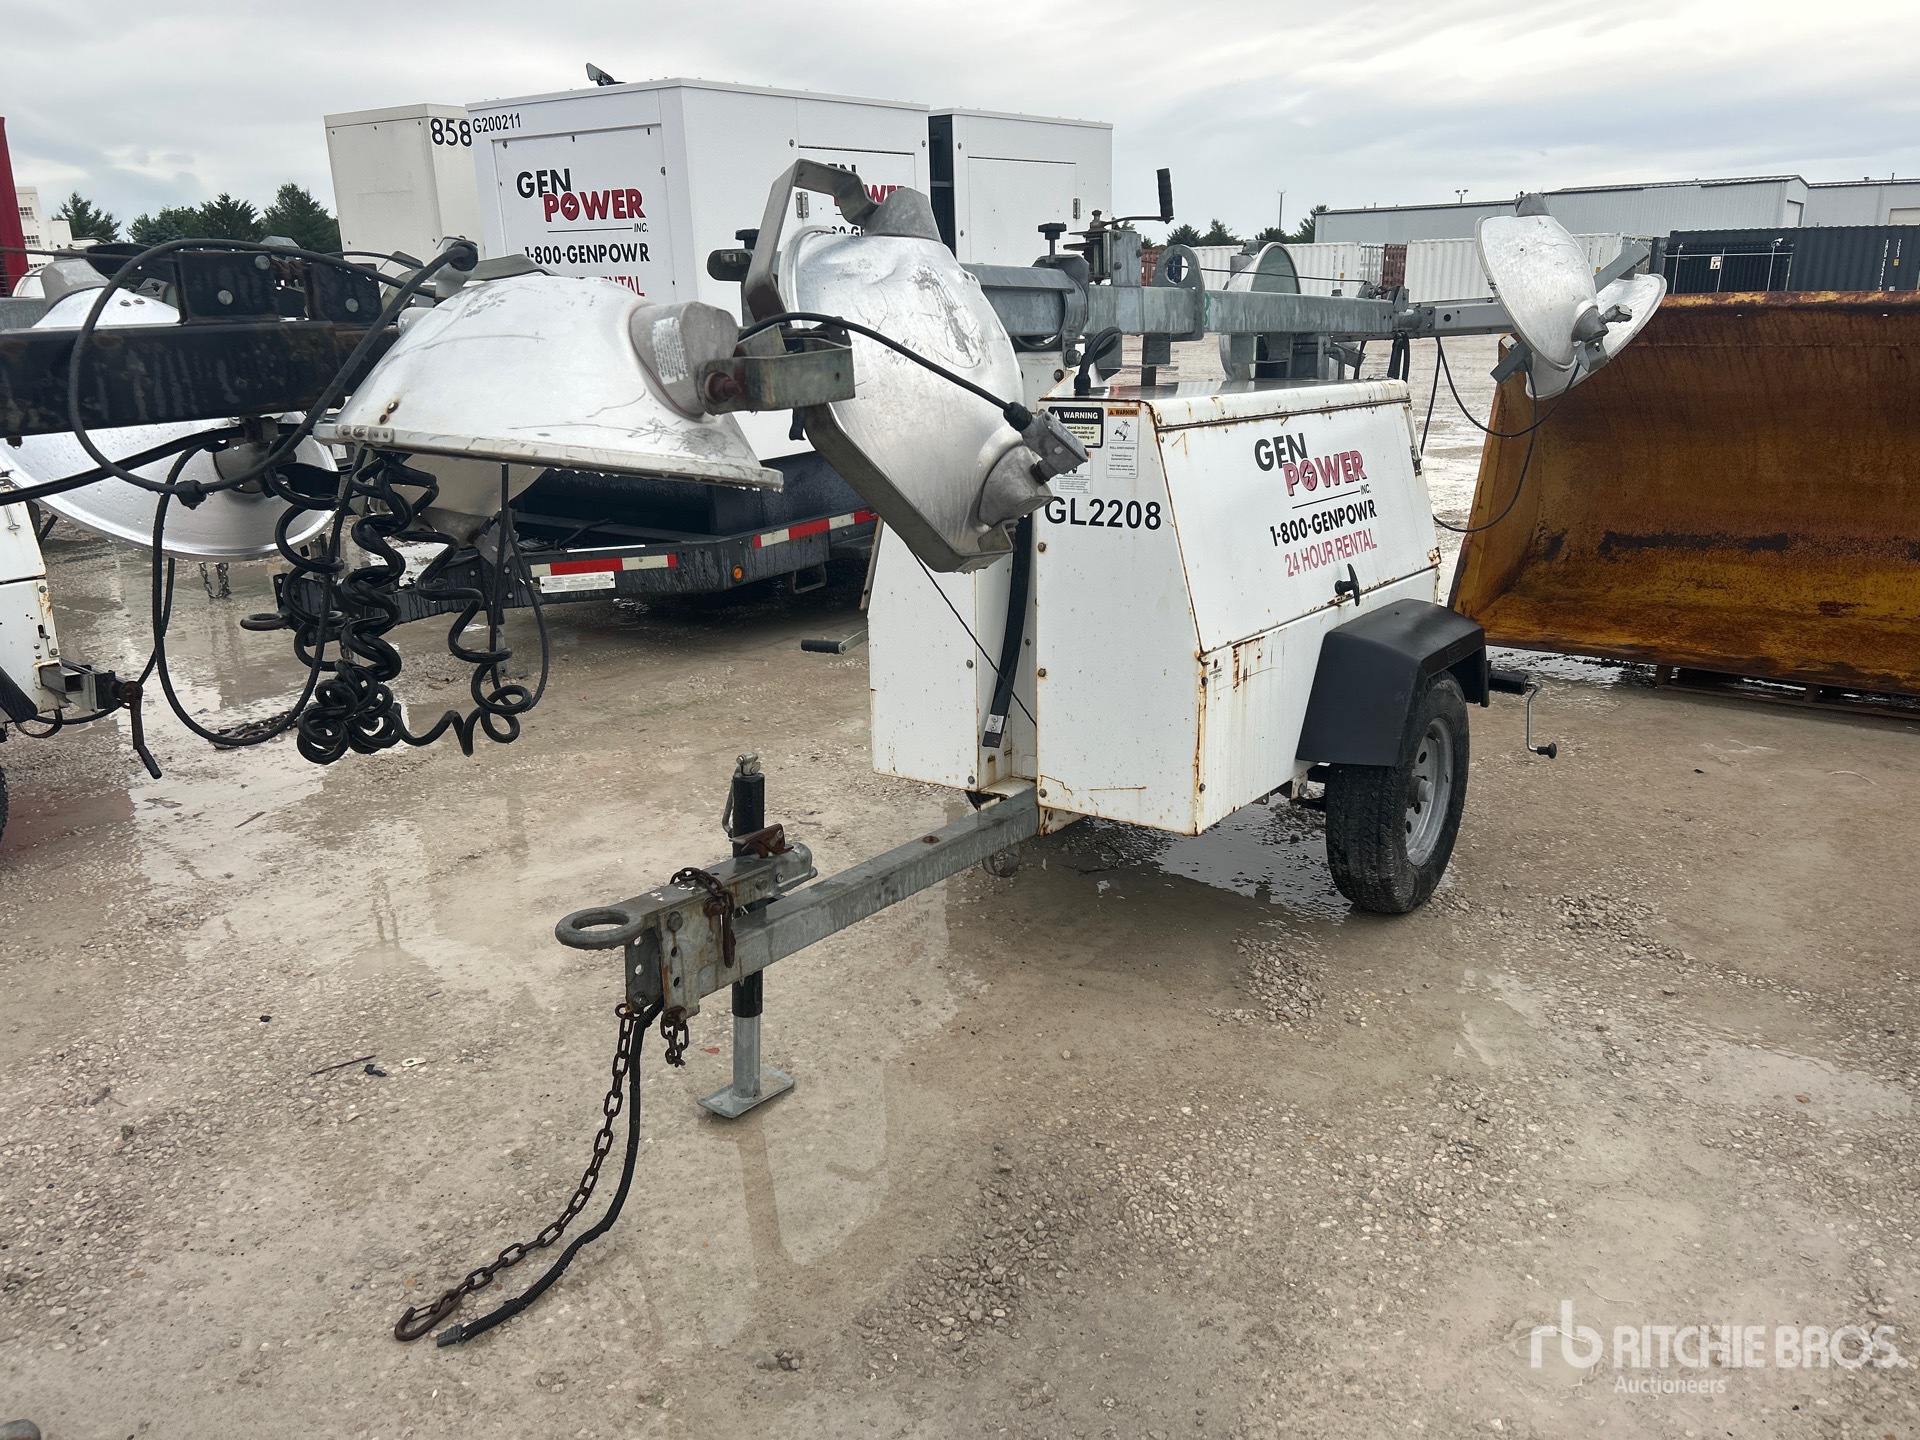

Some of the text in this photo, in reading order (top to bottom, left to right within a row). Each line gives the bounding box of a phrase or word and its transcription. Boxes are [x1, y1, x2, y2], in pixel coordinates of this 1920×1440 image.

[430, 118, 472, 147] 858
[472, 112, 521, 133] G200211
[516, 168, 572, 198] GEN
[543, 188, 646, 222] POWER
[633, 222, 649, 233] INC.
[1063, 411, 1098, 419] WARNING
[1254, 432, 1308, 471] GEN
[1283, 450, 1367, 497] POWER
[1360, 483, 1372, 495] INC.
[1044, 496, 1161, 530] GL2208
[1269, 499, 1378, 546] 1-800-GENPOWR
[1284, 528, 1378, 578] 24 HOUR RENTAL
